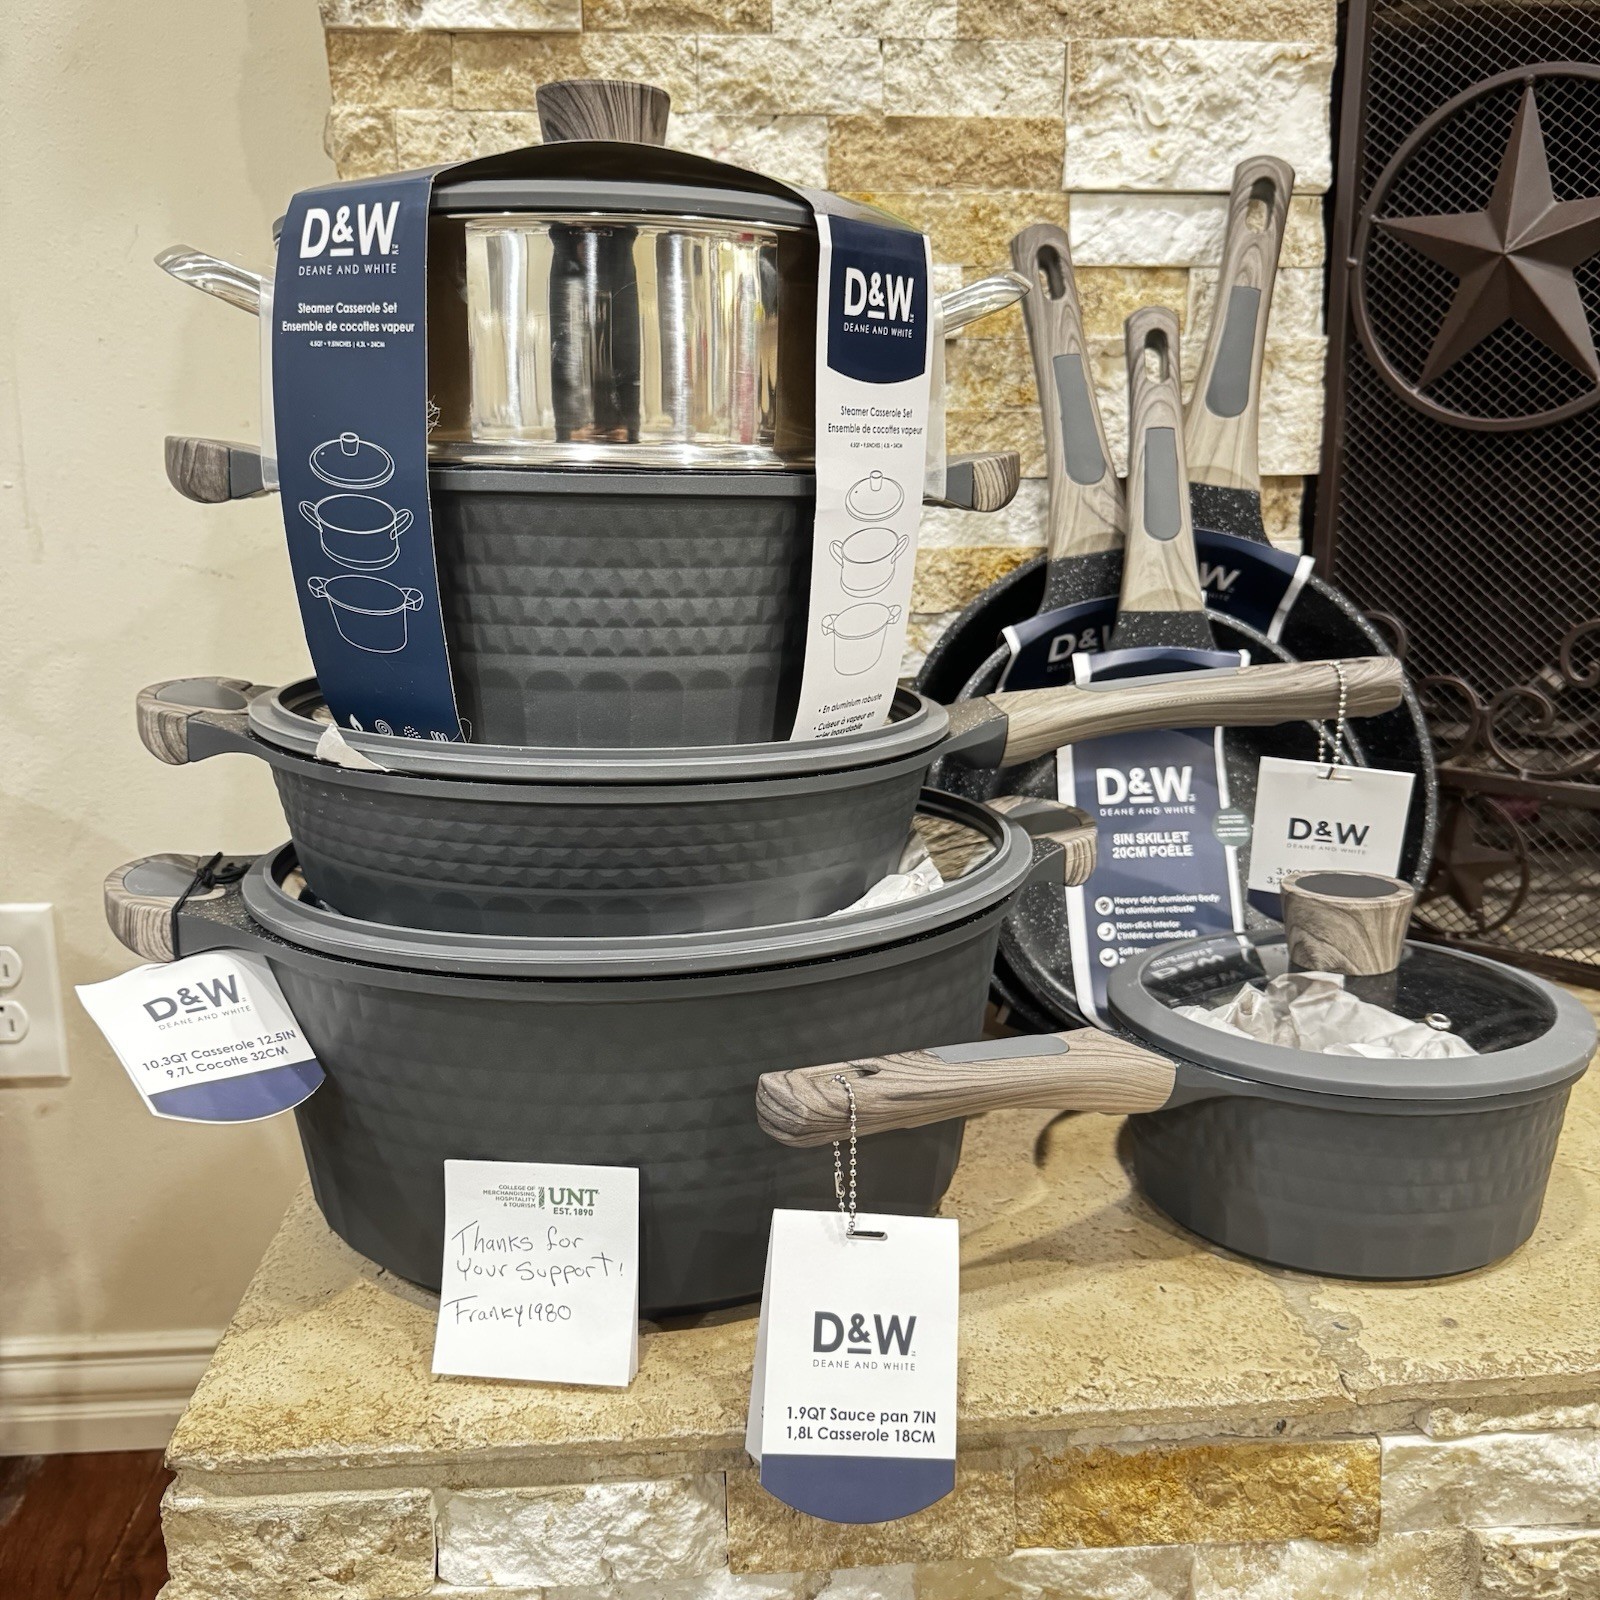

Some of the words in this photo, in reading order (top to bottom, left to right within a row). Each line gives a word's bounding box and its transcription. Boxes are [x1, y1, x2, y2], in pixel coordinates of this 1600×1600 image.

[300, 201, 400, 258] D&W
[299, 265, 332, 276] DEANE
[337, 264, 359, 275] AND
[364, 263, 397, 274] WHITE
[844, 267, 914, 322] D&W
[298, 303, 334, 313] Steamer
[336, 302, 380, 313] Casserole
[383, 302, 397, 313] Set
[282, 321, 323, 332] Ensemble
[325, 321, 337, 332] de
[340, 321, 379, 332] cocottes
[382, 323, 415, 334] vapeur
[844, 322, 869, 334] DEANE
[872, 324, 888, 335] AND
[891, 325, 913, 338] WHITE
[841, 406, 868, 416] Steamer
[870, 407, 901, 417] Casserole
[903, 408, 913, 418] Set
[828, 423, 860, 433] Ensemble
[862, 424, 871, 434] de
[872, 425, 900, 434] cocottes
[901, 427, 923, 436] vapeur
[823, 705, 830, 713] En
[831, 699, 861, 711] aluminium
[862, 694, 882, 704] robuste
[818, 720, 840, 730] Cuiseur
[847, 713, 866, 723] vapeur
[1096, 766, 1193, 804] D&W
[1100, 807, 1134, 816] DEANE
[1139, 806, 1160, 815] AND
[1164, 805, 1196, 814] WHITE
[1113, 833, 1134, 844] 8IN
[1135, 831, 1190, 844] SKILLET
[1287, 817, 1370, 846] D&W
[1112, 846, 1147, 859] 20CM
[1150, 843, 1193, 857] POÊLE
[1114, 897, 1139, 905] Heavy
[1140, 896, 1157, 905] duty
[1158, 894, 1197, 903] aluminium
[1198, 893, 1220, 903] body
[1115, 907, 1124, 915] En
[1125, 906, 1165, 915] aluminium
[1166, 905, 1196, 913] robuste
[1116, 921, 1152, 929] Non-stick
[143, 974, 240, 1022] D&W
[158, 1018, 193, 1031] DEANE
[197, 1012, 218, 1022] AND
[222, 1005, 252, 1017] WHITE
[142, 1052, 187, 1072] 10.3QT
[191, 1040, 255, 1060] Casserole
[257, 1029, 296, 1047] 12.5IN
[166, 1064, 193, 1079] 9,7L
[196, 1055, 248, 1073] Cocotte
[250, 1046, 289, 1061] 32CM
[548, 1187, 598, 1206] UNT
[553, 1207, 572, 1215] EST.
[574, 1208, 593, 1216] 1890
[452, 1220, 534, 1255] Thanks
[547, 1226, 584, 1251] for
[444, 1295, 571, 1327] Franky1980
[812, 1311, 917, 1356] D&W
[813, 1359, 850, 1369] DEANE
[855, 1361, 878, 1370] AND
[883, 1361, 916, 1371] WHITE
[786, 1406, 826, 1421] 1.9QT
[830, 1407, 876, 1422] Sauce
[880, 1411, 909, 1425] pan
[913, 1411, 936, 1424] 7IN
[786, 1426, 813, 1441] 1,8L
[818, 1427, 889, 1442] Casserole
[894, 1429, 936, 1443] 18CM
